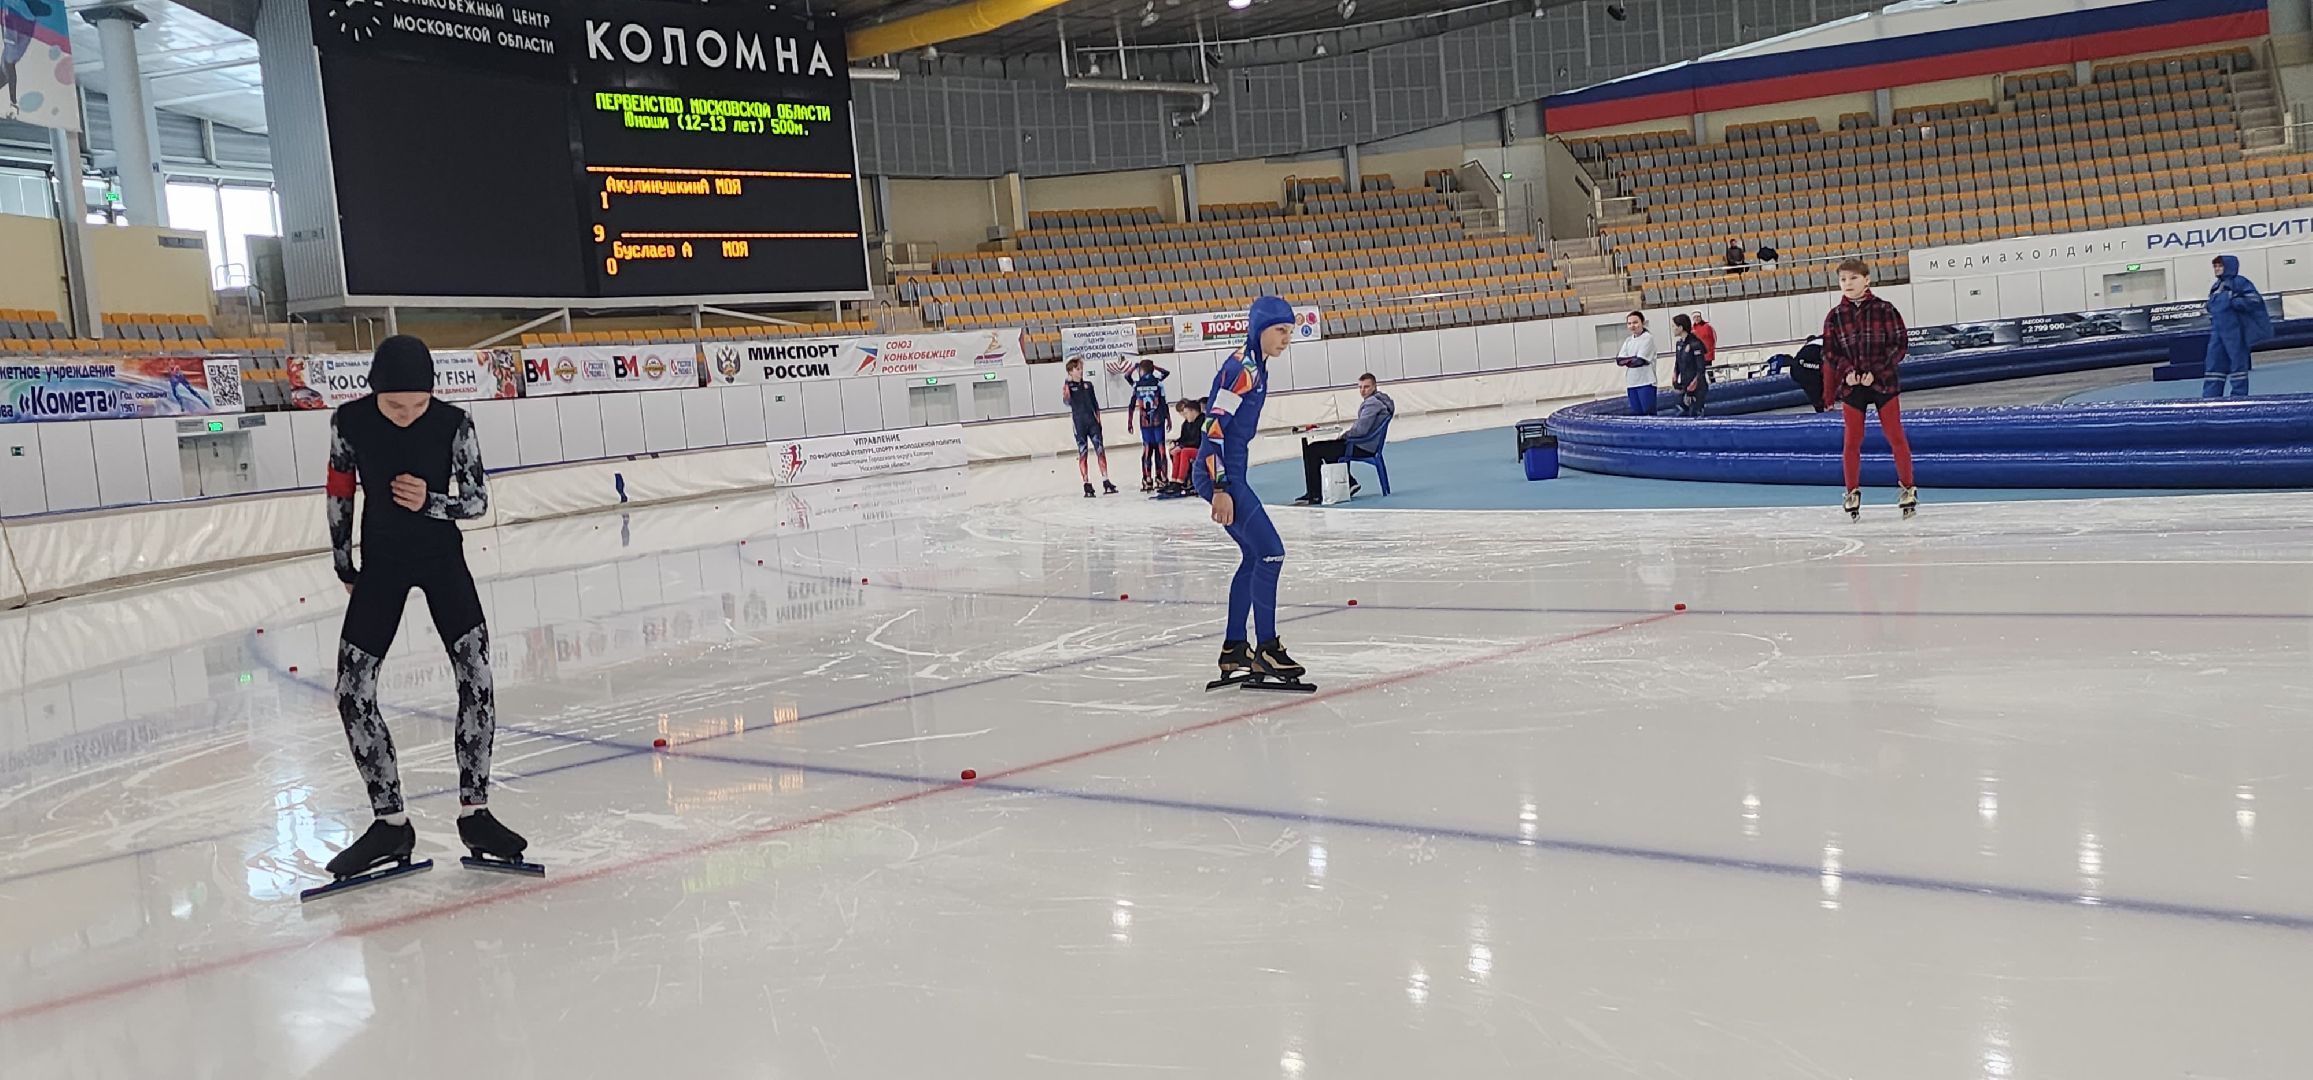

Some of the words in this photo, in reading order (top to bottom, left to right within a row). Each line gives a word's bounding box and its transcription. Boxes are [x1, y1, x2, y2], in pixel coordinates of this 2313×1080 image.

[393, 0, 505, 21] ЬКОБЕЖНЫЙ
[512, 8, 551, 28] ЦЕНТР
[393, 13, 492, 43] МОСКОВСКОЙ
[498, 31, 554, 54] ОБЛАСТИ
[585, 19, 835, 78] КОЛОМНА
[595, 92, 684, 114] ПЕРВЕНСТВО
[689, 98, 771, 119] МОСКОВСКОЙ
[776, 103, 831, 122] ОБЛАСТИ
[624, 111, 669, 129] Юноши
[677, 115, 727, 133] (12-13
[733, 119, 764, 134] лет)
[770, 119, 809, 136] 500м.
[605, 175, 710, 195] АкулинушкинА
[714, 178, 742, 195] МОЯ
[600, 191, 609, 209] 1
[593, 224, 605, 242] 9
[2147, 217, 2313, 250] РАДИОСИТ
[613, 240, 676, 260] Буслаев
[681, 241, 693, 257] А
[722, 241, 749, 257] МОЯ
[1929, 240, 2128, 270] медиахолдинг
[748, 344, 840, 362] МИНСПОРТ
[885, 340, 912, 350] СОЮЗ
[883, 349, 957, 362] КОНЬКОБЕЖЦЕВ
[44, 364, 116, 382] учреждение
[764, 363, 831, 380] РОССИИ
[881, 363, 918, 373] РОССИИ
[446, 370, 476, 385] FISH
[853, 434, 901, 446] УПРАВЛЕНИЕ
